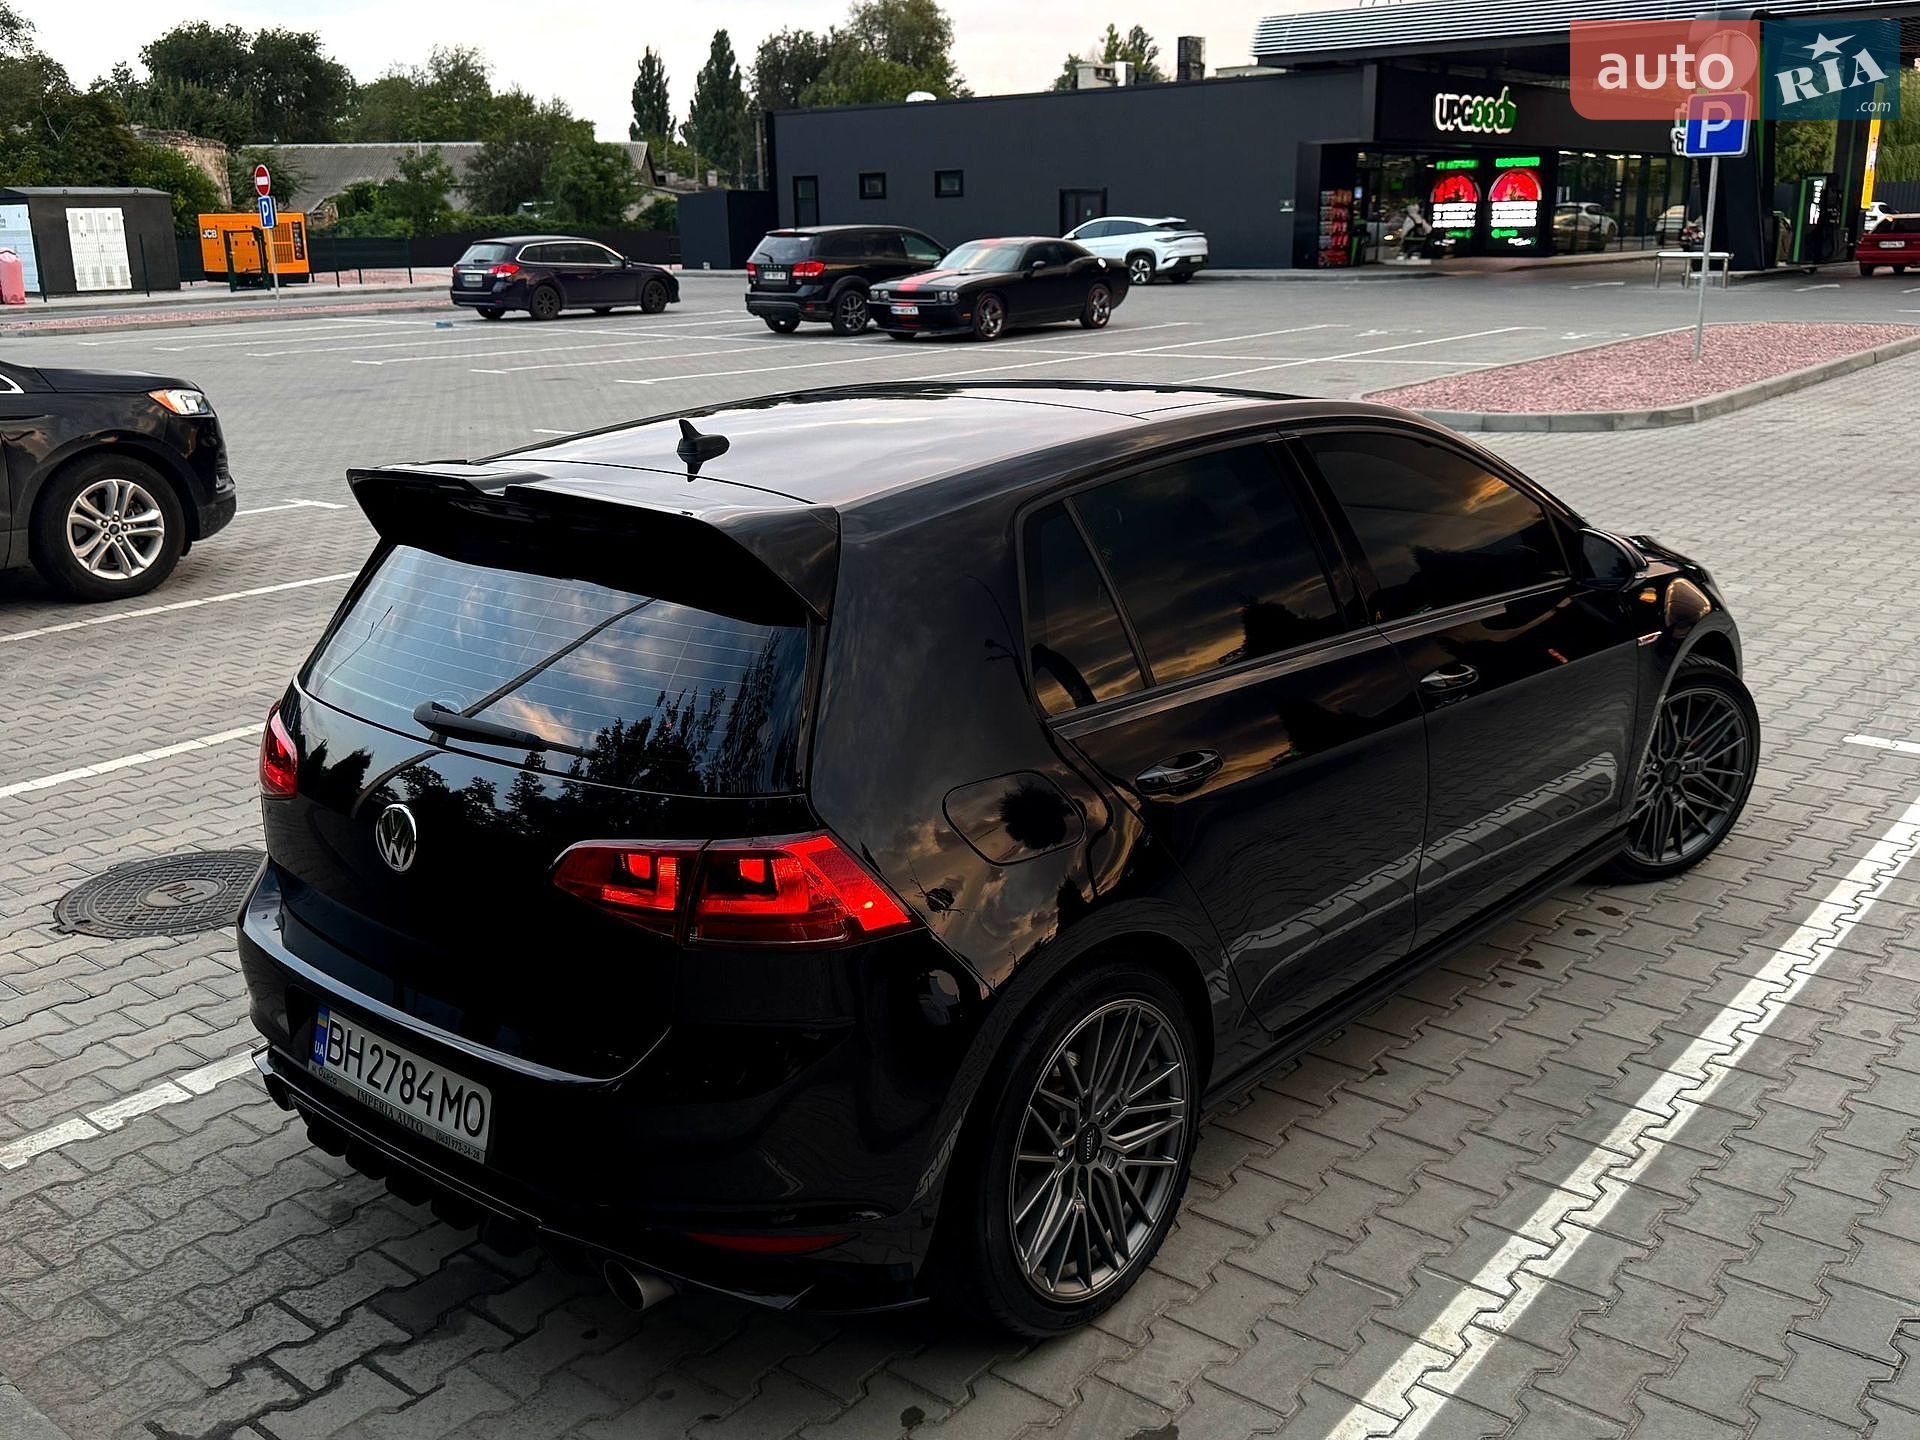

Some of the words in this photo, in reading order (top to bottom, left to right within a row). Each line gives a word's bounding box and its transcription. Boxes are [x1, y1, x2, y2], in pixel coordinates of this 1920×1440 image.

[1698, 101, 1733, 149] P
[261, 200, 270, 225] P
[202, 229, 218, 239] JCB
[314, 1040, 324, 1057] UA
[358, 1088, 394, 1119] IMPERIA
[398, 1112, 424, 1133] AUTO
